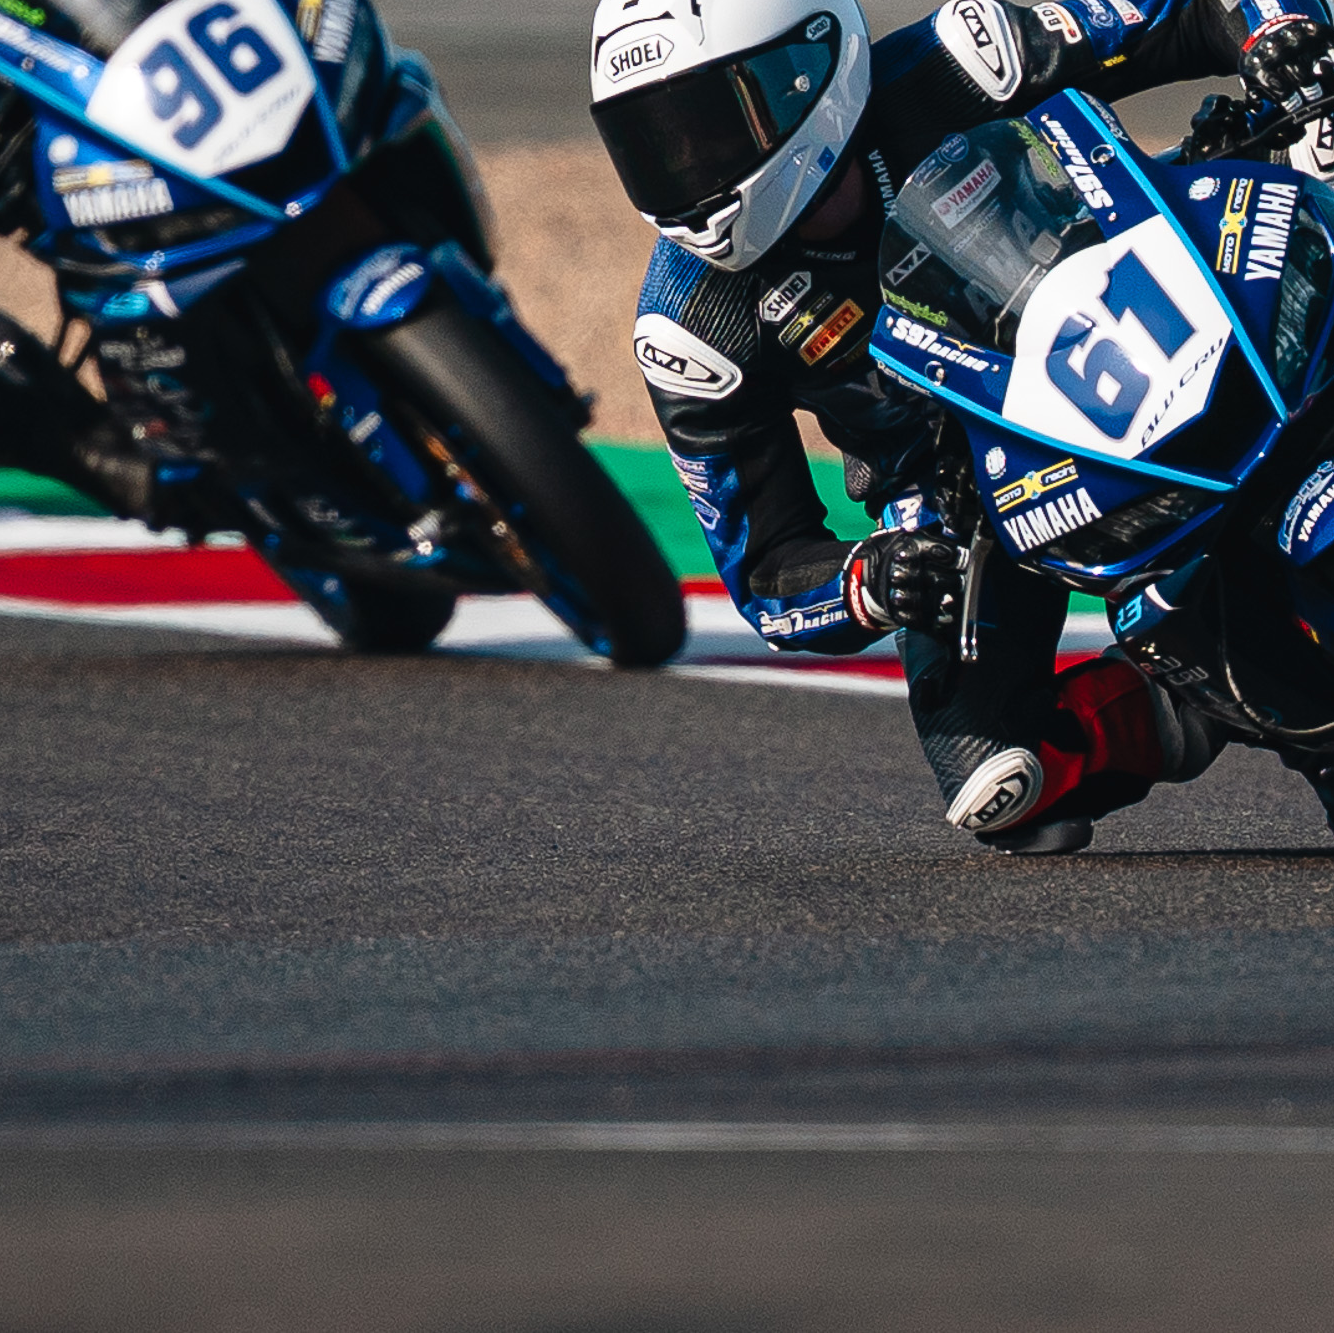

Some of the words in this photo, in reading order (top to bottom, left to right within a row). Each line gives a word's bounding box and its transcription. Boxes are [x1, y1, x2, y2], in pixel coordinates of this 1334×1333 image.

[140, 2, 283, 150] 96
[610, 40, 662, 77] SHOEI
[947, 161, 994, 206] YAMAHA
[1222, 236, 1235, 273] MOTO
[1244, 182, 1298, 281] YAMAHA
[767, 274, 807, 317] SHOEI
[1045, 248, 1199, 443] 61
[1141, 390, 1174, 448] BLU
[1179, 338, 1223, 388] CRU
[995, 487, 1022, 507] MOTO
[1002, 487, 1103, 552] YAMAHA
